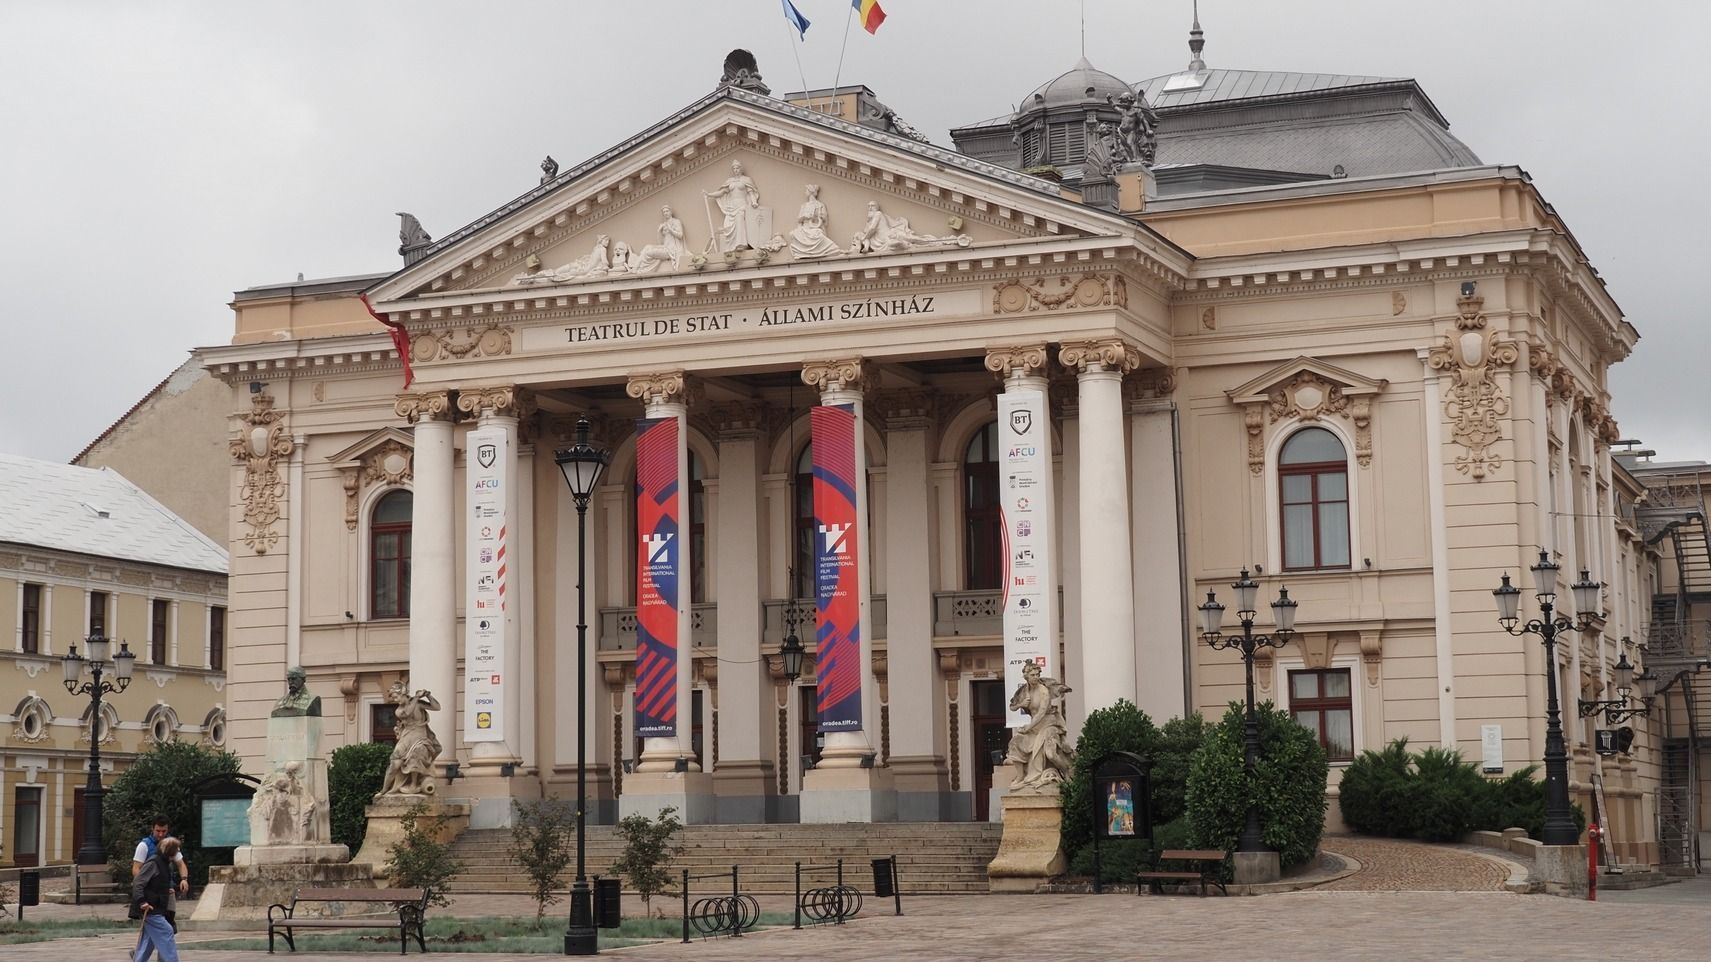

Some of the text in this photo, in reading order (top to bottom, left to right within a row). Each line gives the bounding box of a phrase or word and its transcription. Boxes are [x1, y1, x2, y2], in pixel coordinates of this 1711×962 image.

[565, 321, 650, 342] TEATRUL
[654, 318, 680, 335] DE
[686, 314, 733, 333] STAT
[758, 305, 834, 327] ÁLLAMI
[840, 294, 935, 320] SZÍNHÁZ
[1014, 415, 1028, 424] BT
[481, 450, 493, 458] BT
[1008, 447, 1036, 458] AFCU
[475, 479, 499, 489] AFCU
[822, 719, 858, 727] oradea.tiff.ro
